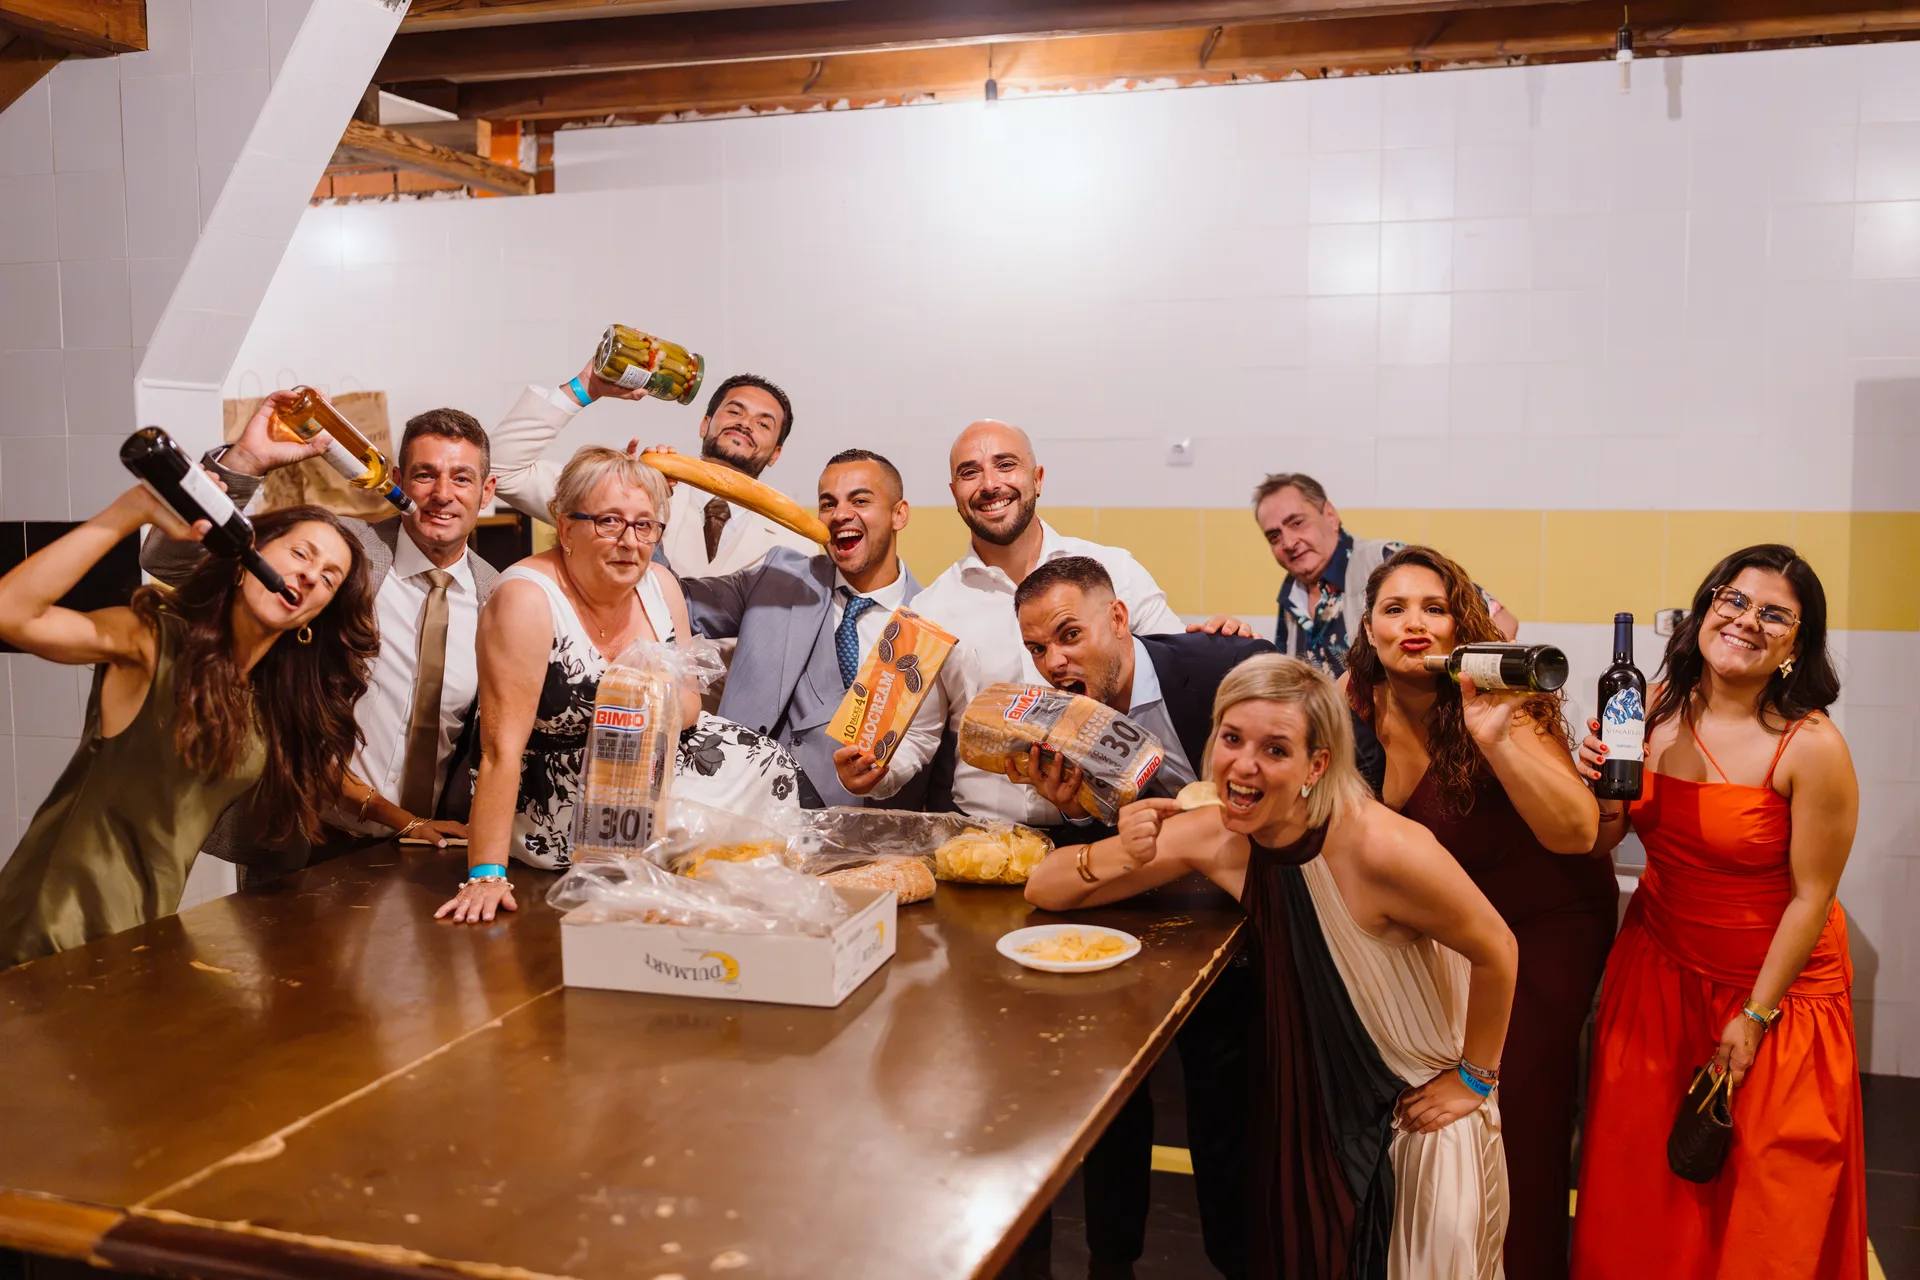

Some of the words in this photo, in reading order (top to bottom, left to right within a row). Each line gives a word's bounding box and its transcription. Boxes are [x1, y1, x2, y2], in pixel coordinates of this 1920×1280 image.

[844, 725, 856, 739] 10
[855, 698, 866, 706] 4
[858, 670, 896, 752] CAOCREAM
[1008, 688, 1042, 720] BIMO
[1100, 720, 1140, 758] 30
[1136, 755, 1161, 789] BIMBO
[599, 807, 640, 841] 30
[644, 952, 721, 981] DULMART
